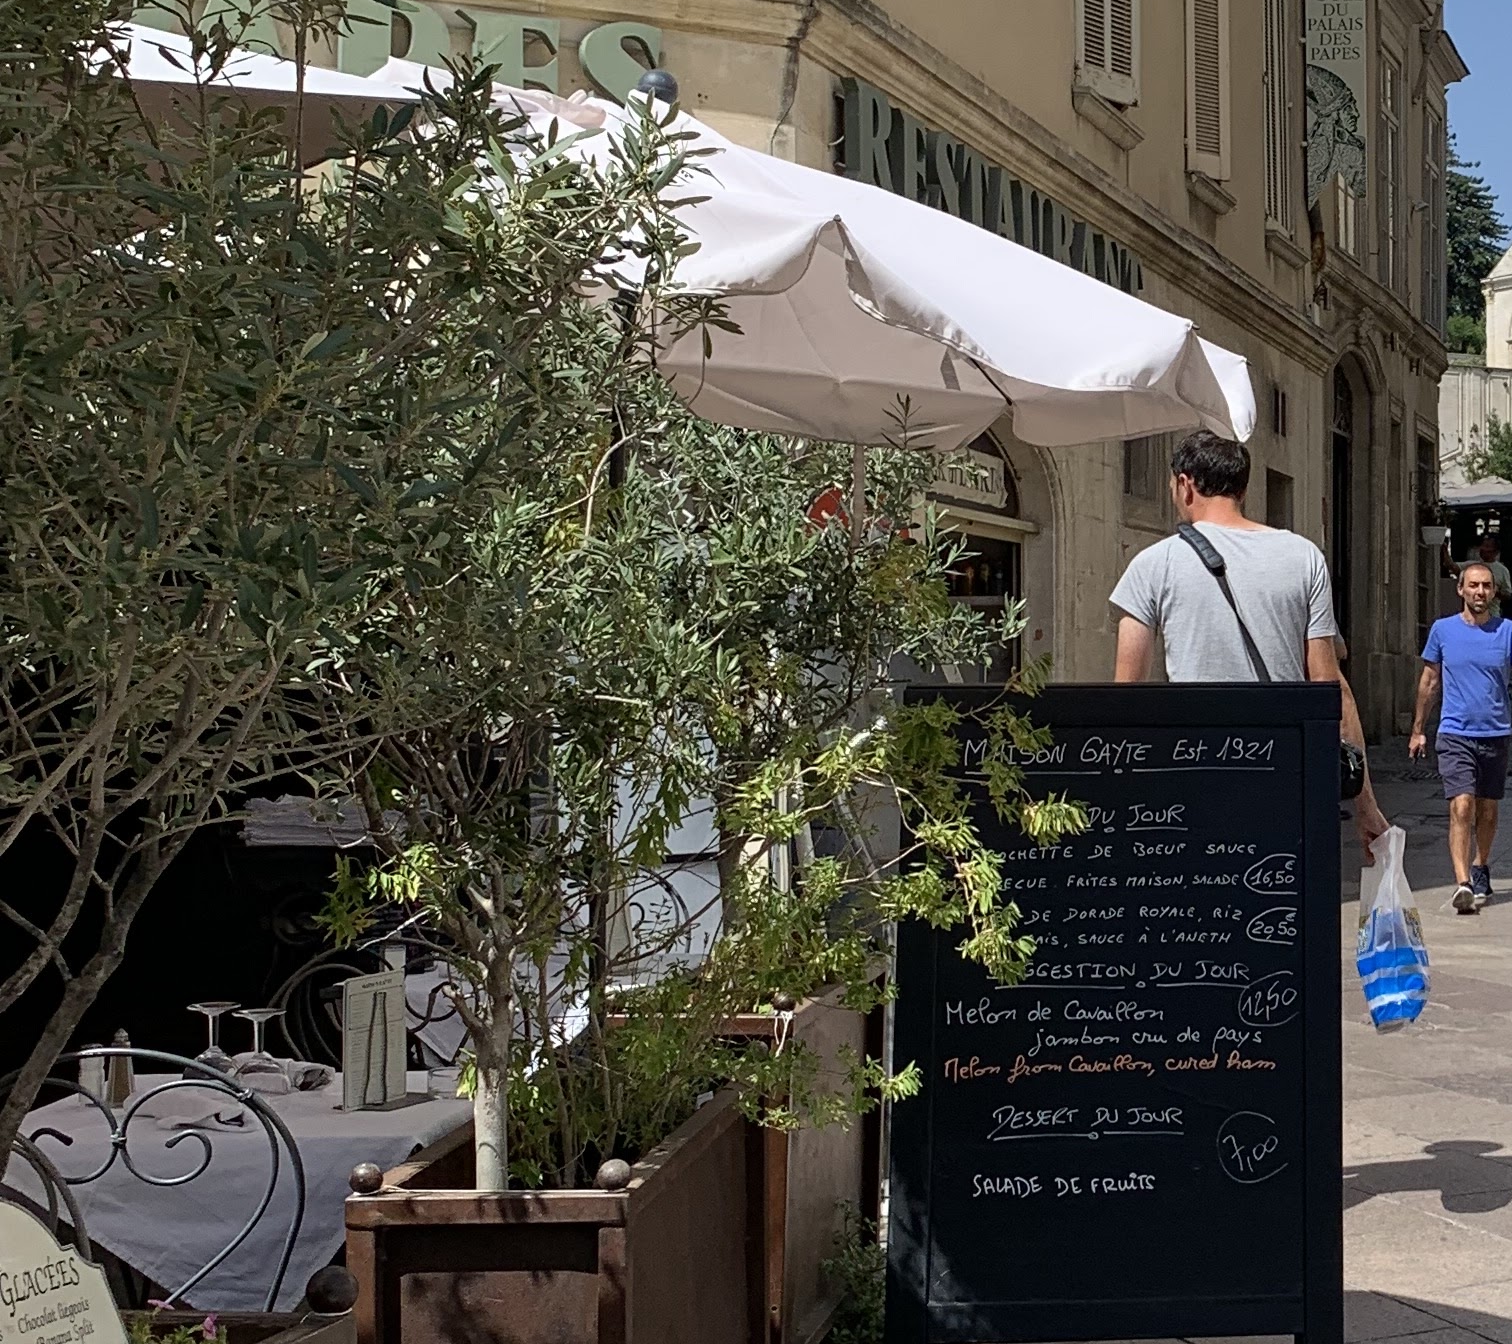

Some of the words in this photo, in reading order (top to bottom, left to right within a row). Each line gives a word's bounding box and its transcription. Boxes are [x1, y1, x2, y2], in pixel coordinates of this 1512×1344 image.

[1322, 2, 1349, 18] DU
[1307, 17, 1363, 32] PALAIS
[1319, 32, 1352, 46] DES
[1310, 46, 1360, 61] PAPES
[1216, 736, 1275, 761] 1921
[1087, 806, 1116, 827] DU
[1126, 803, 1187, 826] JOUR
[1087, 844, 1113, 860] DE
[1205, 843, 1257, 855] SAUCE
[1192, 873, 1240, 887] SALADE
[1022, 909, 1052, 925] DE
[1062, 906, 1125, 923] DORADE
[1077, 933, 1125, 945] SAUCE
[1160, 928, 1232, 944] L'ANETH
[1149, 962, 1182, 980] DU
[1194, 960, 1250, 981] JOUR
[946, 996, 1017, 1025] Melon
[1027, 1000, 1052, 1023] de
[1063, 999, 1164, 1024] Cavaillon
[1027, 1026, 1121, 1057] jambon
[1131, 1031, 1169, 1045] cru
[1176, 1027, 1201, 1044] de
[1212, 1027, 1264, 1052] pays
[944, 1055, 1001, 1083] Melon
[1007, 1054, 1063, 1084] from
[1164, 1049, 1219, 1071] cured
[1226, 1049, 1276, 1071] ham
[990, 1104, 1079, 1133] DESSERT
[1090, 1107, 1120, 1127] DU
[1126, 1106, 1184, 1126] JOUR
[972, 1174, 1043, 1199] SALADE
[1056, 1176, 1083, 1196] DE
[18, 1307, 58, 1334] Chocolat
